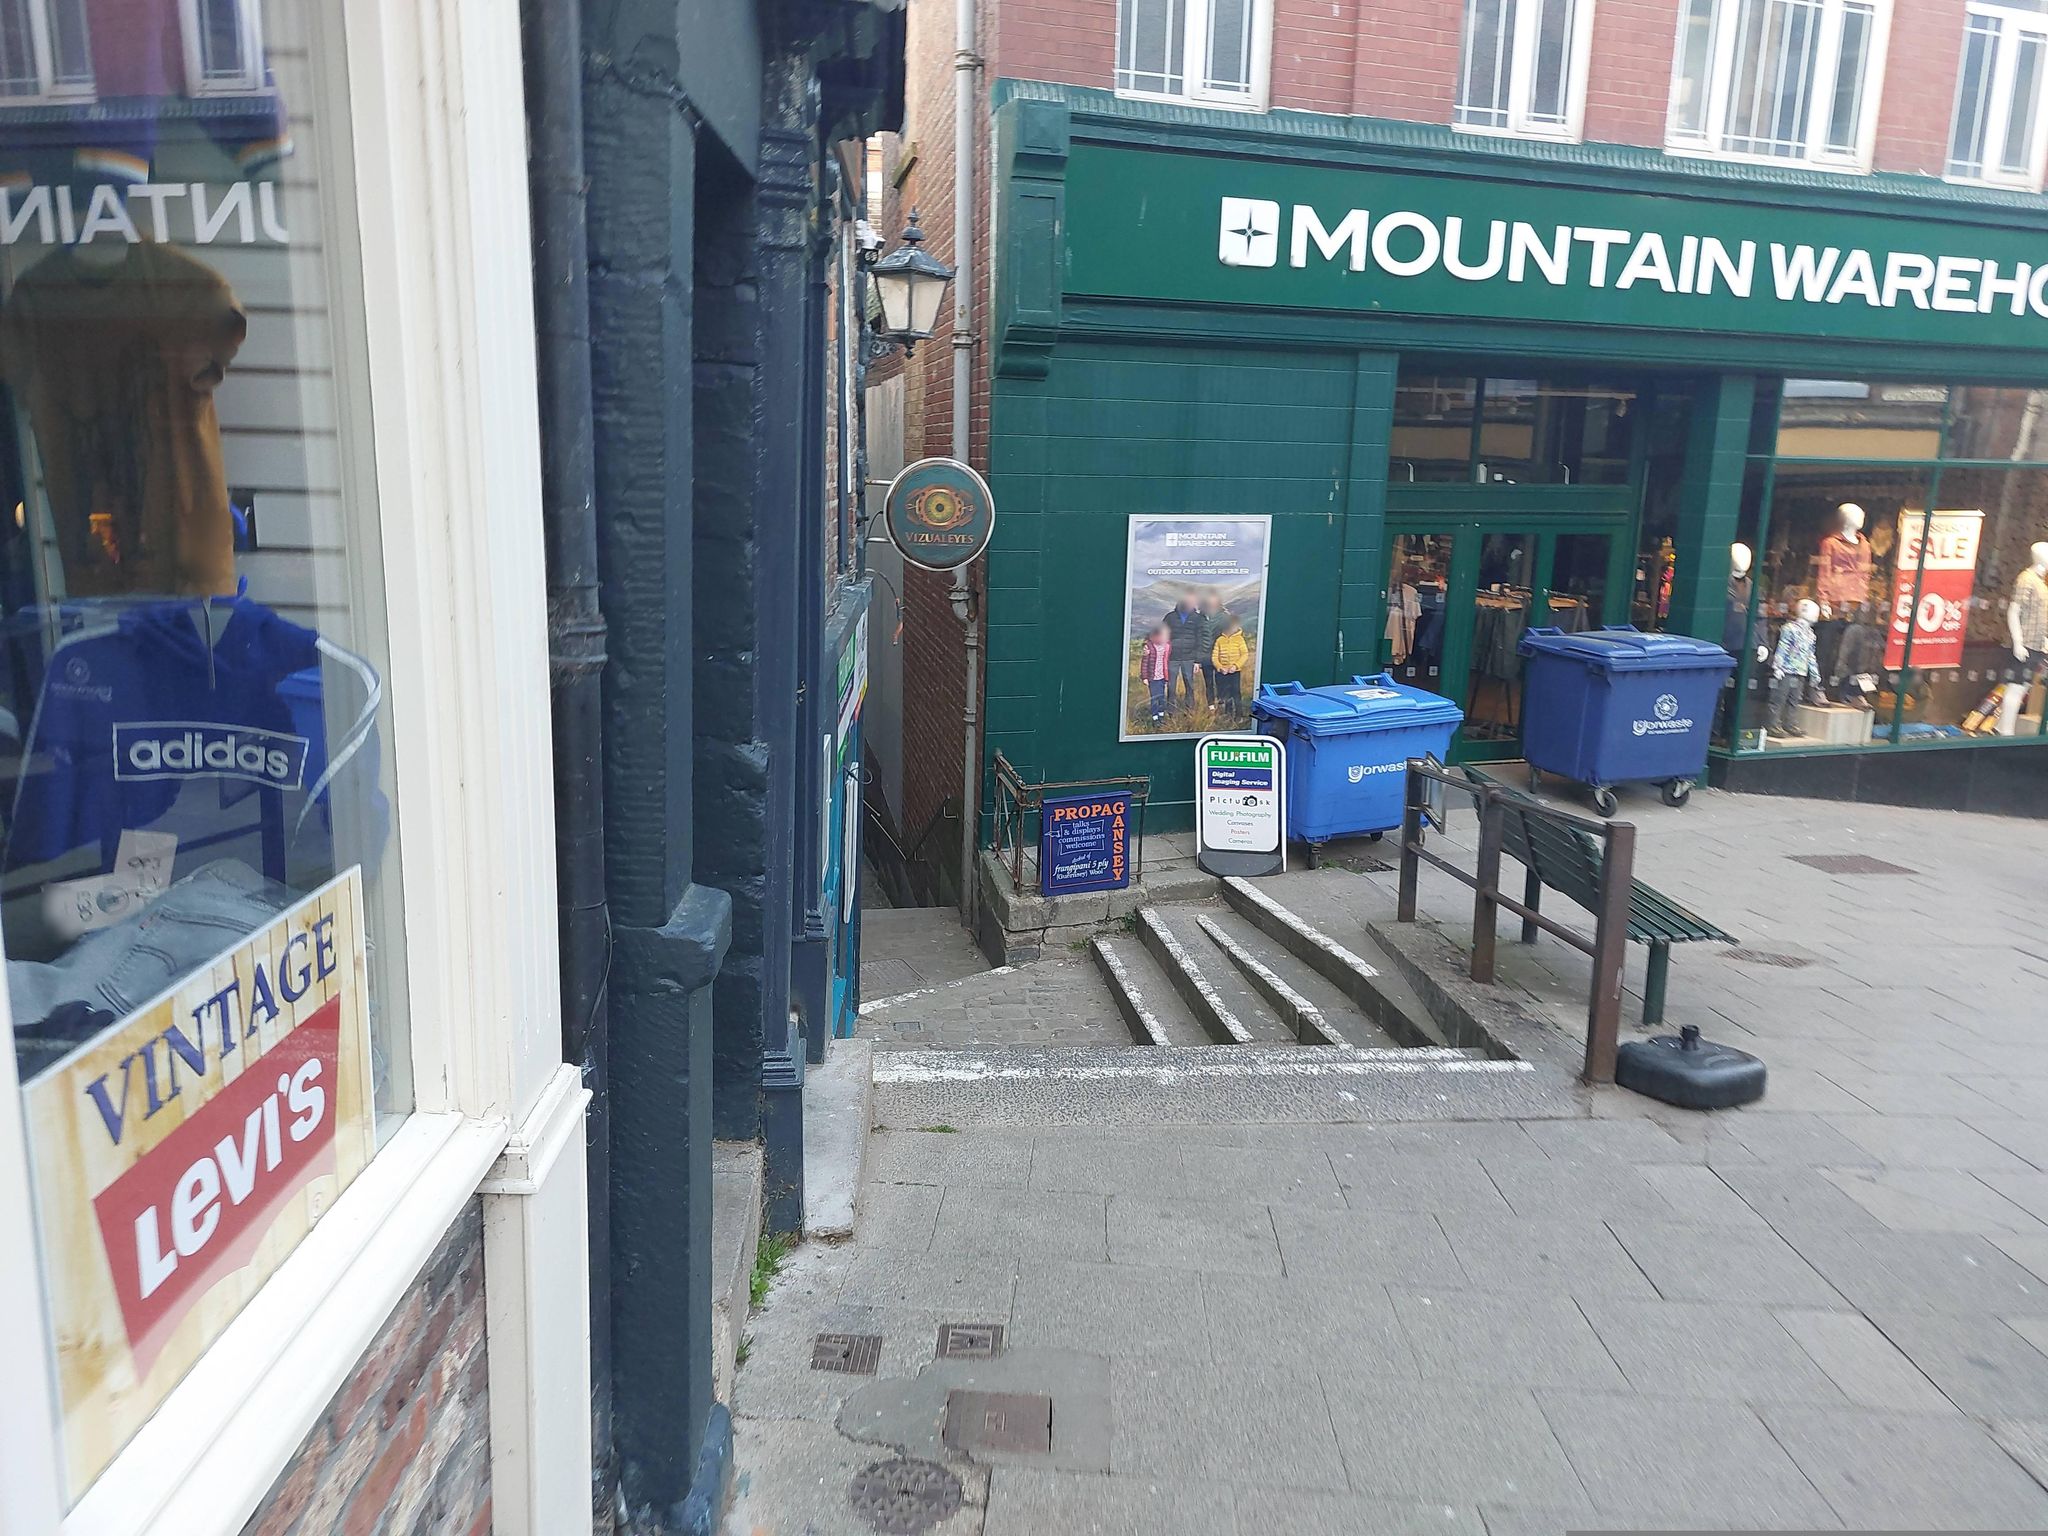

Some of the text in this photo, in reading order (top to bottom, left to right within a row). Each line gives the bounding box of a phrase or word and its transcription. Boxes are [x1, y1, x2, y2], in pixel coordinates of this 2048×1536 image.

[1290, 203, 1757, 298] MOUNTAIN
[905, 532, 974, 543] VIZUALEYES
[1907, 537, 1969, 560] SALE
[129, 732, 289, 779] adidas
[1210, 750, 1270, 763] FUJIFILM
[1348, 760, 1408, 783] yorwast
[1212, 778, 1240, 786] Imaging
[1208, 809, 1271, 818] Wedding Photography
[1071, 826, 1101, 836] displays
[1058, 833, 1106, 844] commissions
[1065, 841, 1097, 850] welcome
[85, 912, 338, 1146] VINTAGE
